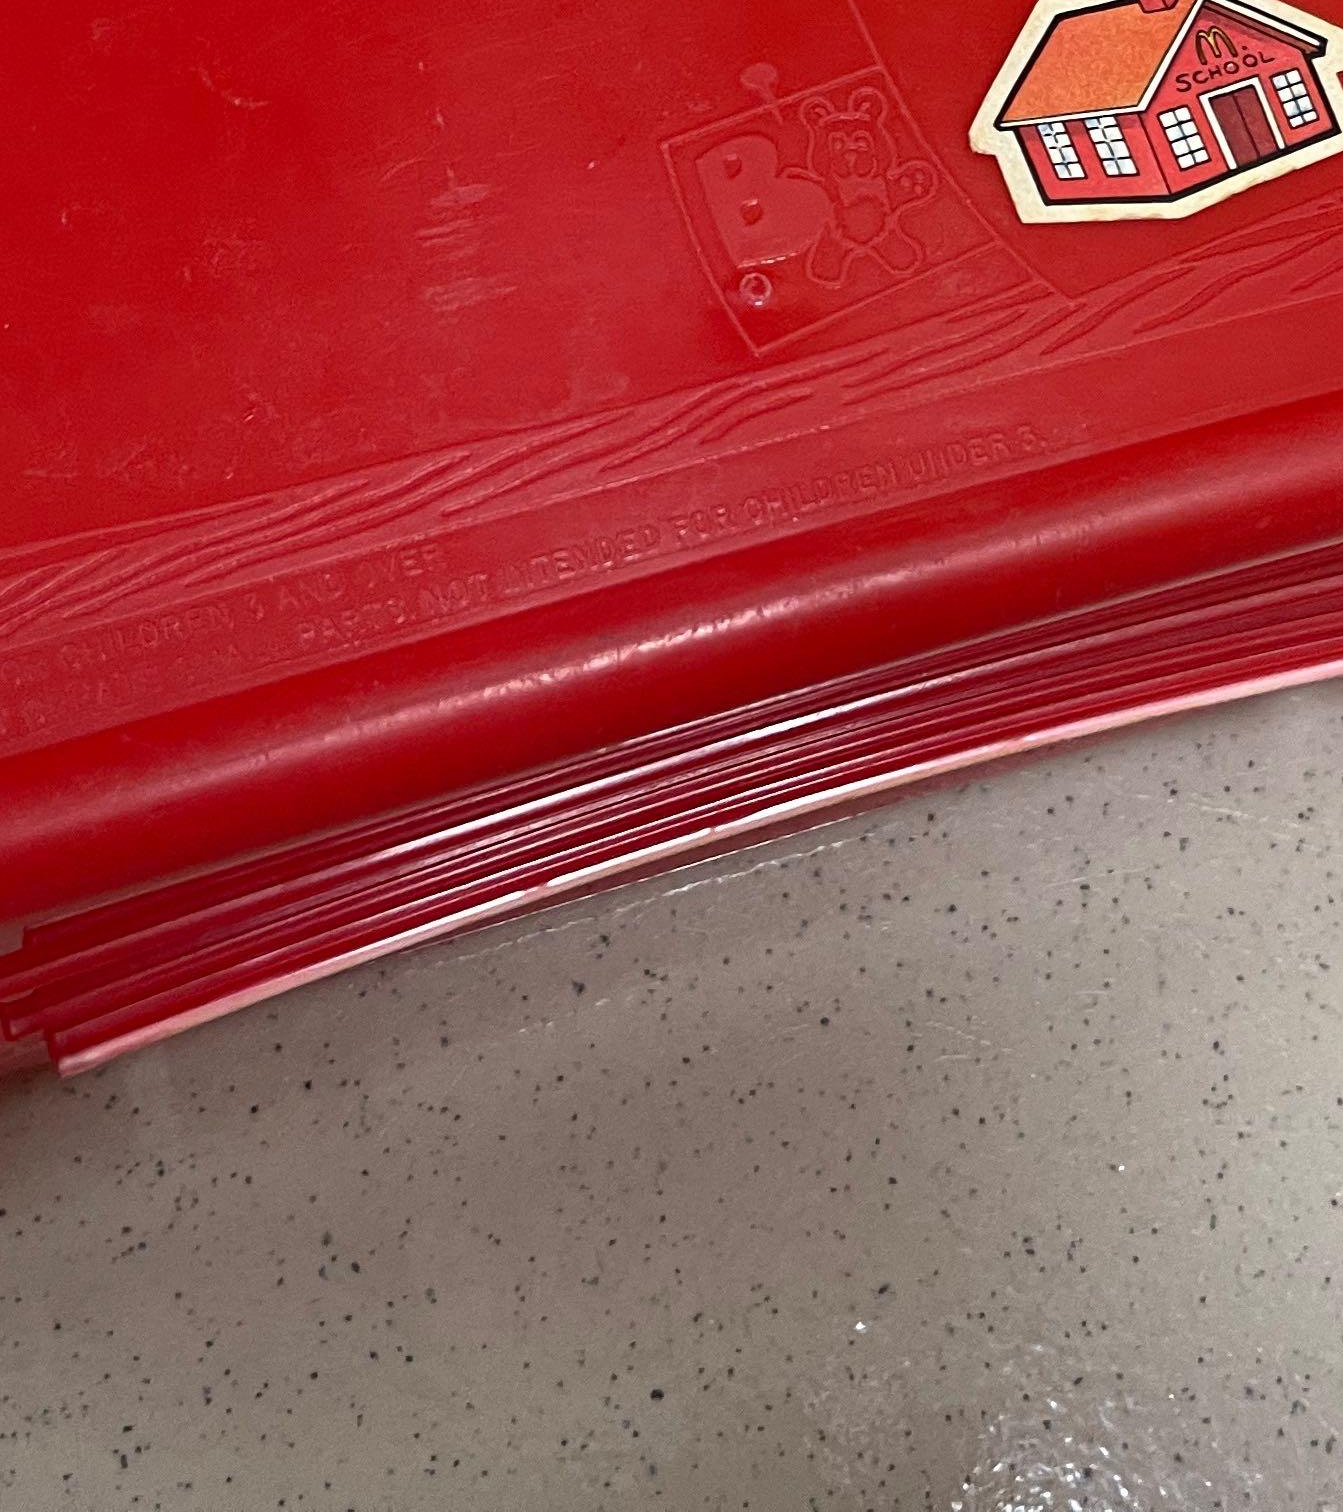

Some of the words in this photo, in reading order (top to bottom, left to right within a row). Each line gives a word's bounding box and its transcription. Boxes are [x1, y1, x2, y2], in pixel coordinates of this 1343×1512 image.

[1175, 51, 1276, 92] SCHOOL
[674, 503, 736, 550] FOR
[741, 462, 900, 530] CHILDREN
